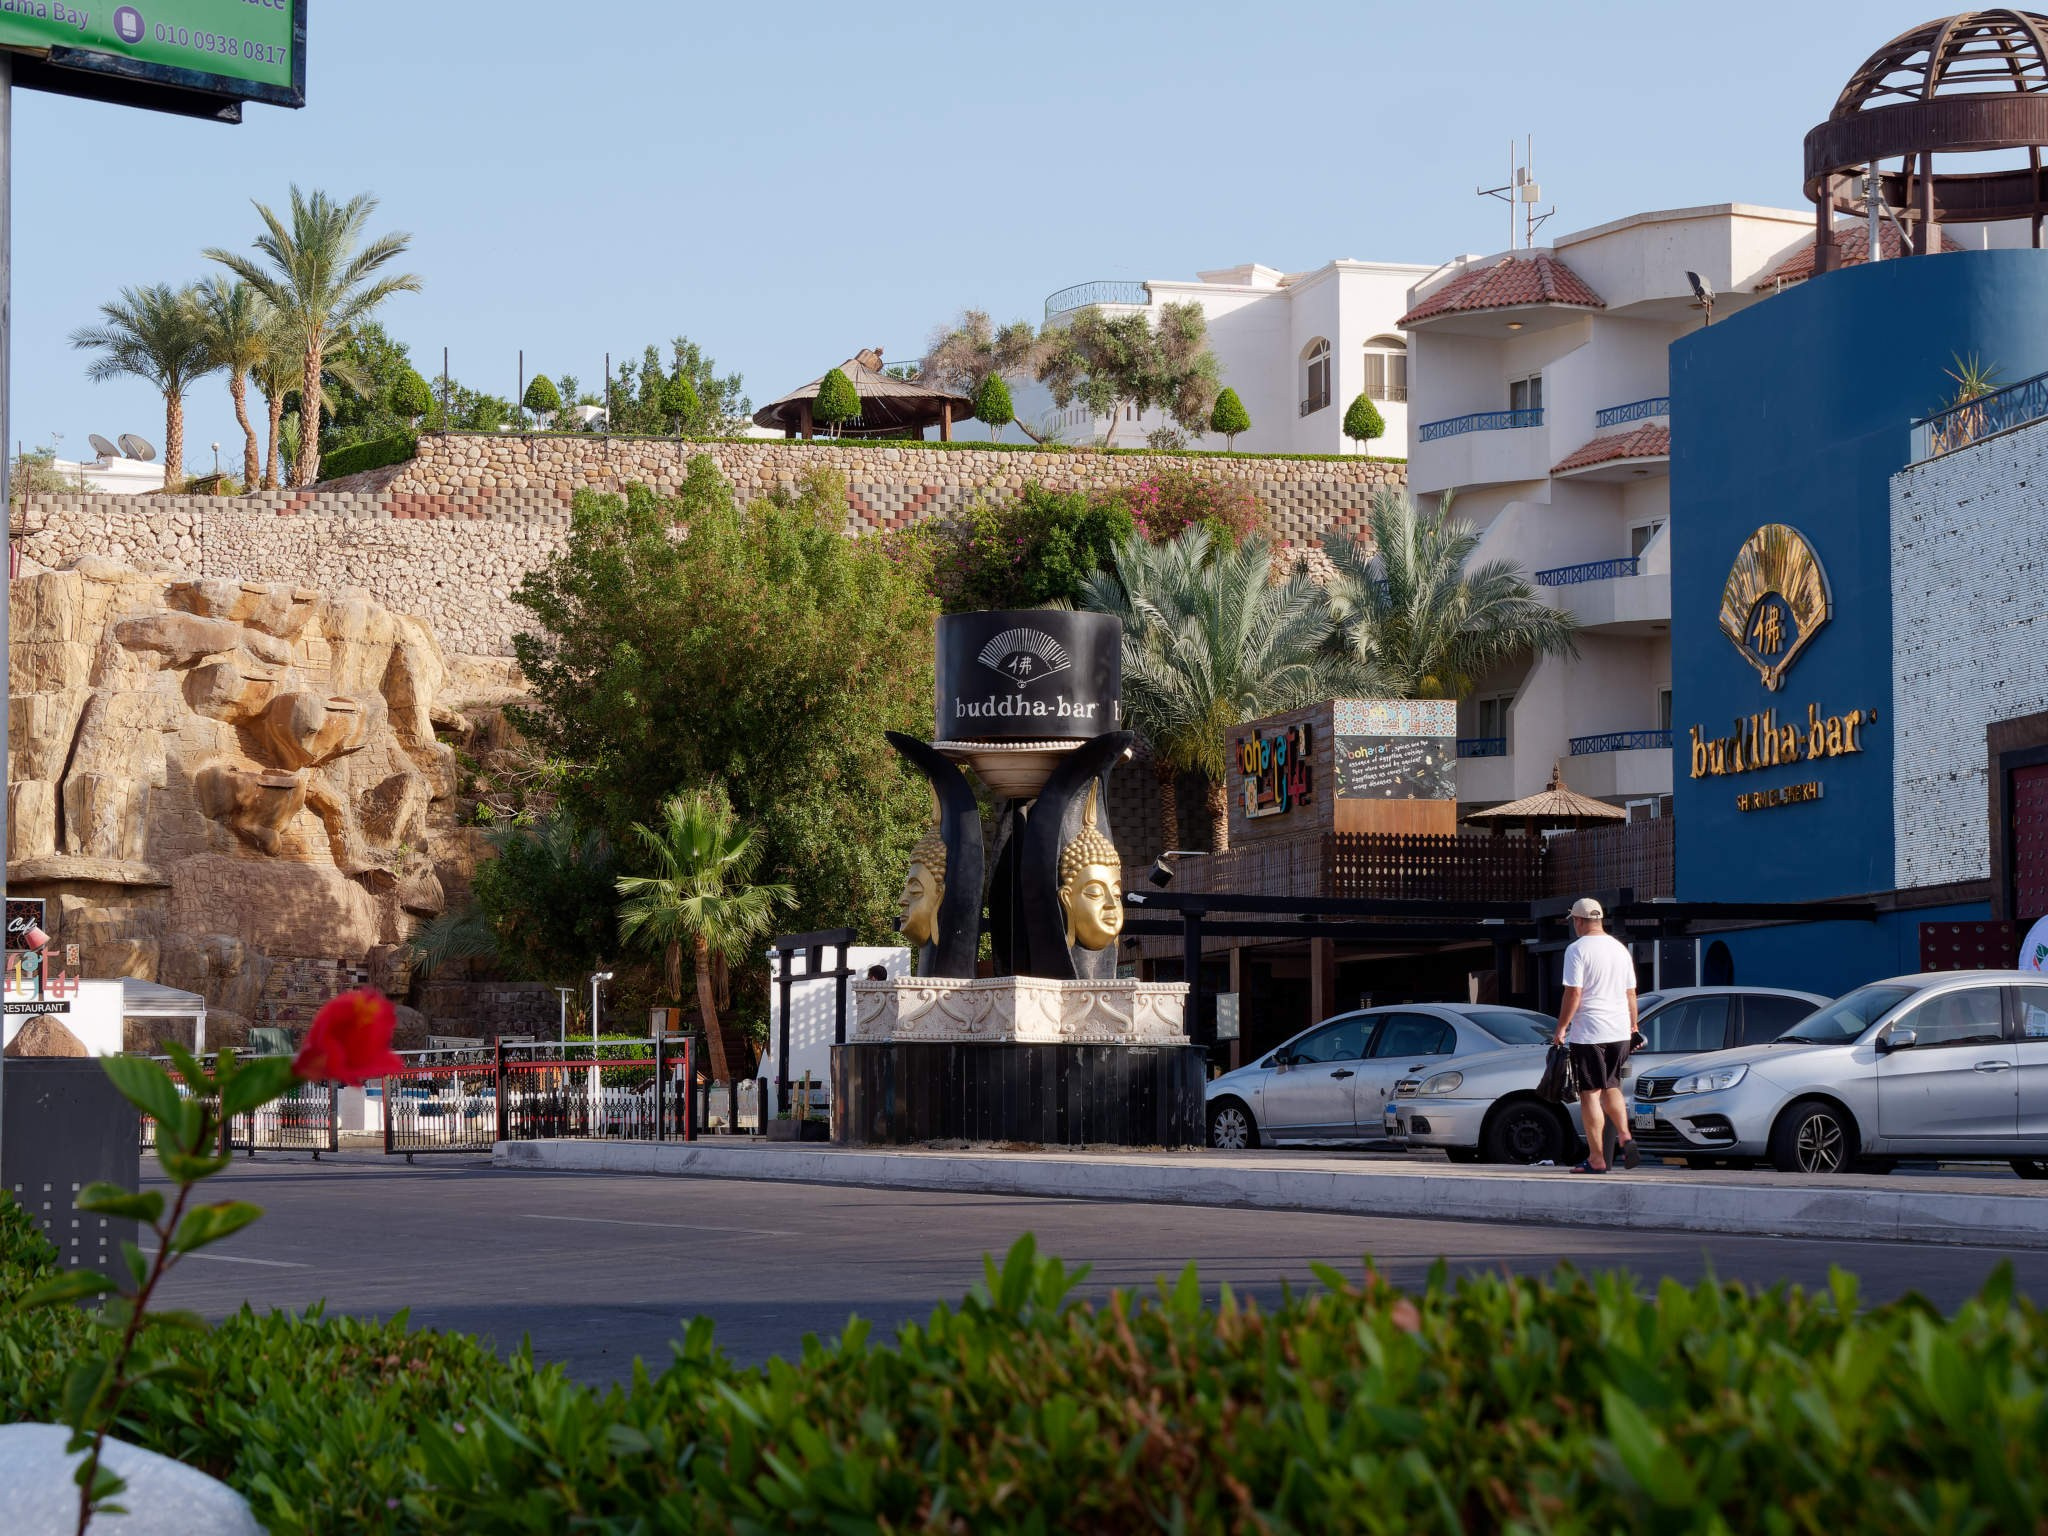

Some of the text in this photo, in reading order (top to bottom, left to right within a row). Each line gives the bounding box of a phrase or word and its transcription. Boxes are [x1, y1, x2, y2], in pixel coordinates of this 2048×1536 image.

[0, 0, 89, 30] ama Bay
[155, 23, 286, 64] 010 0938 0817
[1753, 604, 1780, 654] 佛
[1008, 656, 1032, 675] 佛
[955, 694, 1097, 719] buddha-bar
